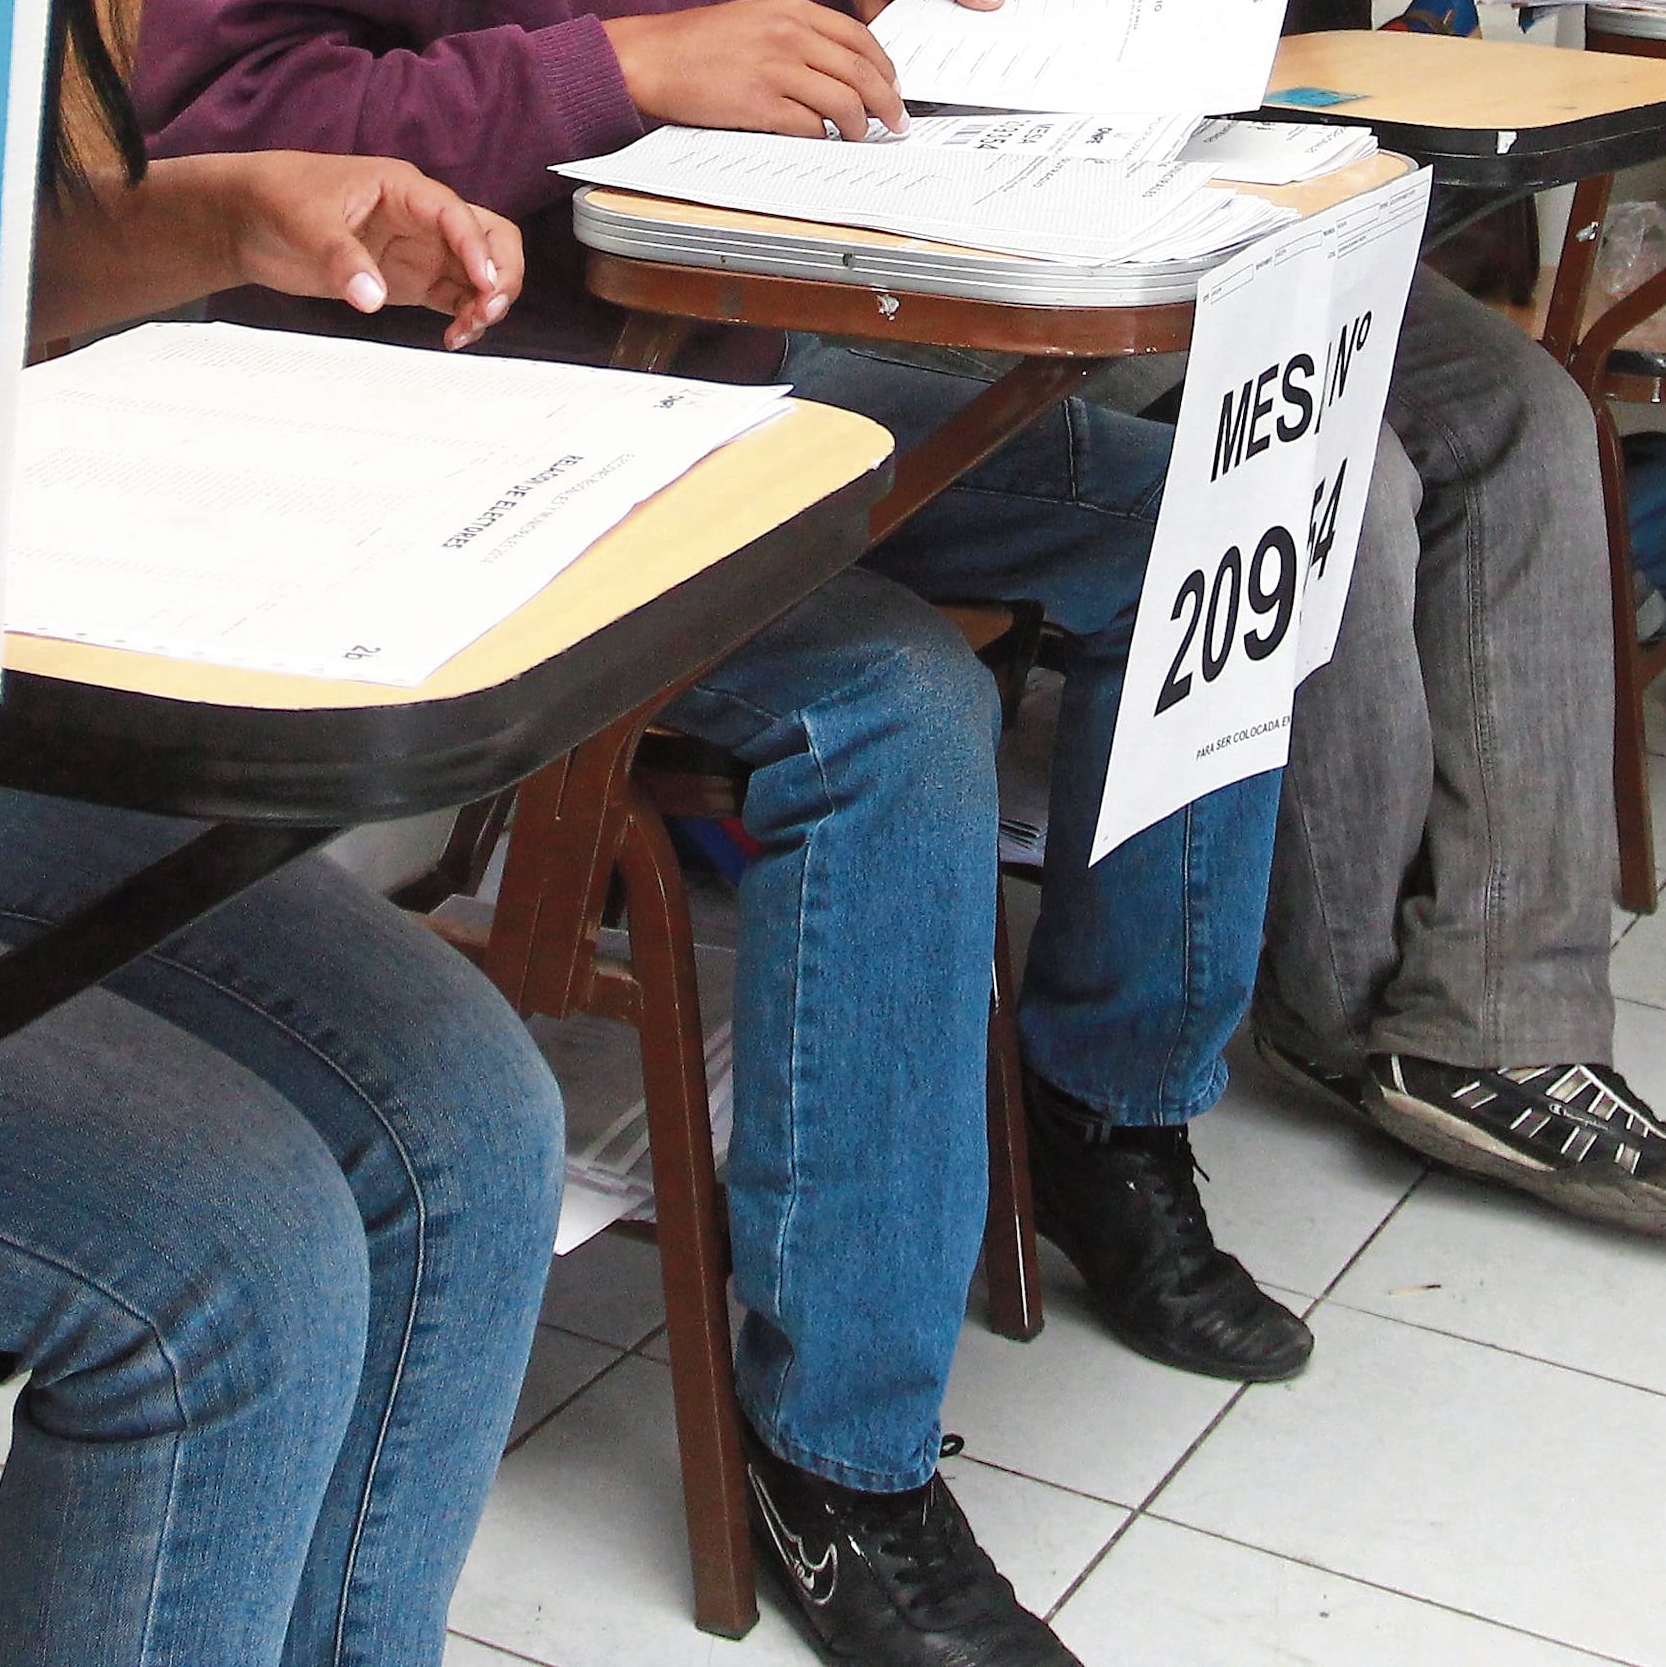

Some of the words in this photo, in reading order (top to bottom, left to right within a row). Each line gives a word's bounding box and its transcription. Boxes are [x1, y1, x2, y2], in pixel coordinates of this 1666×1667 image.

[505, 485, 533, 498] DE
[441, 500, 517, 549] ELECTORES
[1196, 743, 1214, 761] PARA
[1216, 735, 1231, 750] SER
[1234, 719, 1280, 743] COLOCADA
